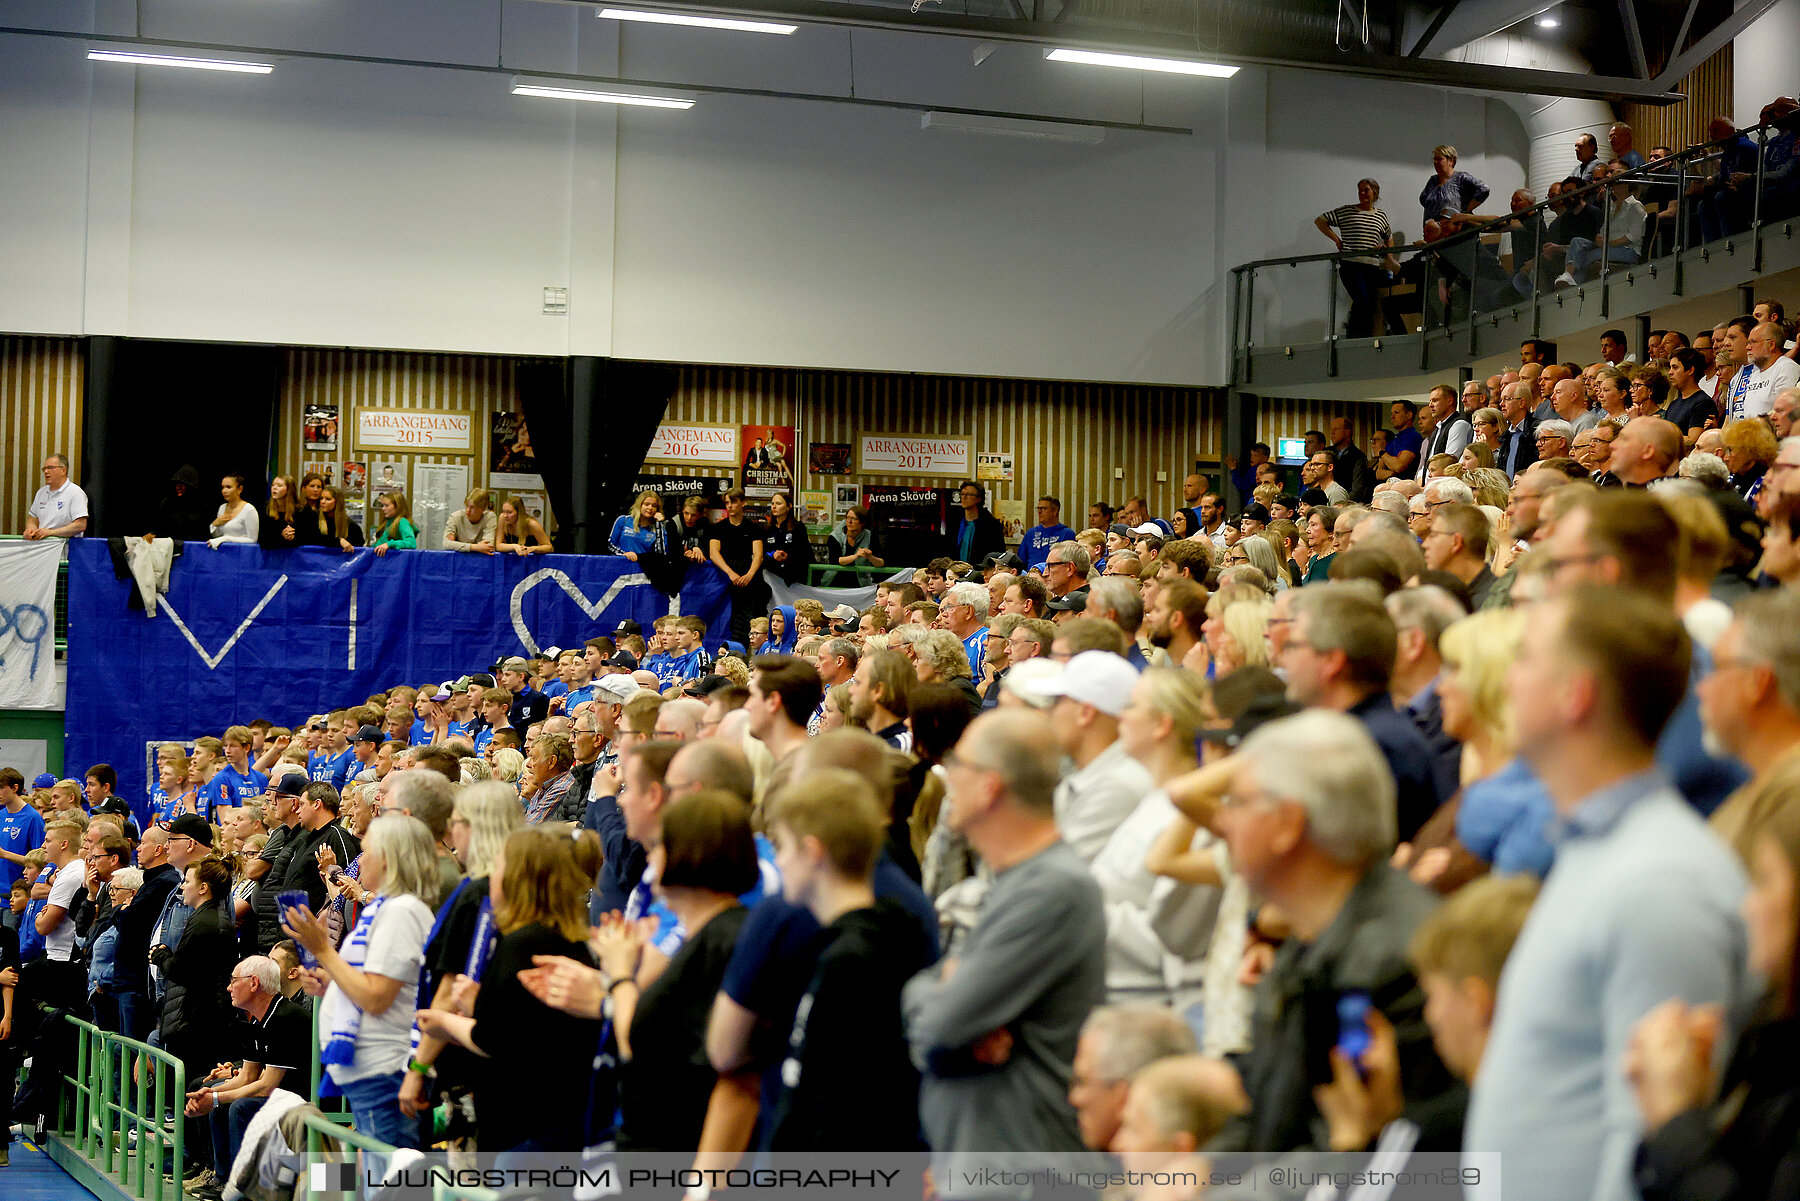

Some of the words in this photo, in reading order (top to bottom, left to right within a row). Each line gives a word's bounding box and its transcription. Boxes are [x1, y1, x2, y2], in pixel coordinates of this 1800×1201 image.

[362, 415, 468, 432] ARRANGEMANG
[396, 430, 433, 444] 2015
[653, 428, 732, 444] ANGEMANG
[663, 442, 699, 456] 2016
[865, 440, 965, 456] ARRANGEMANG
[897, 455, 932, 469] 2017
[746, 469, 788, 479] CHRISTMAS
[756, 477, 778, 485] NIGHT
[632, 482, 663, 493] Arena
[665, 479, 703, 492] Skövde
[868, 492, 898, 503] Arena
[900, 490, 937, 502] Skövde
